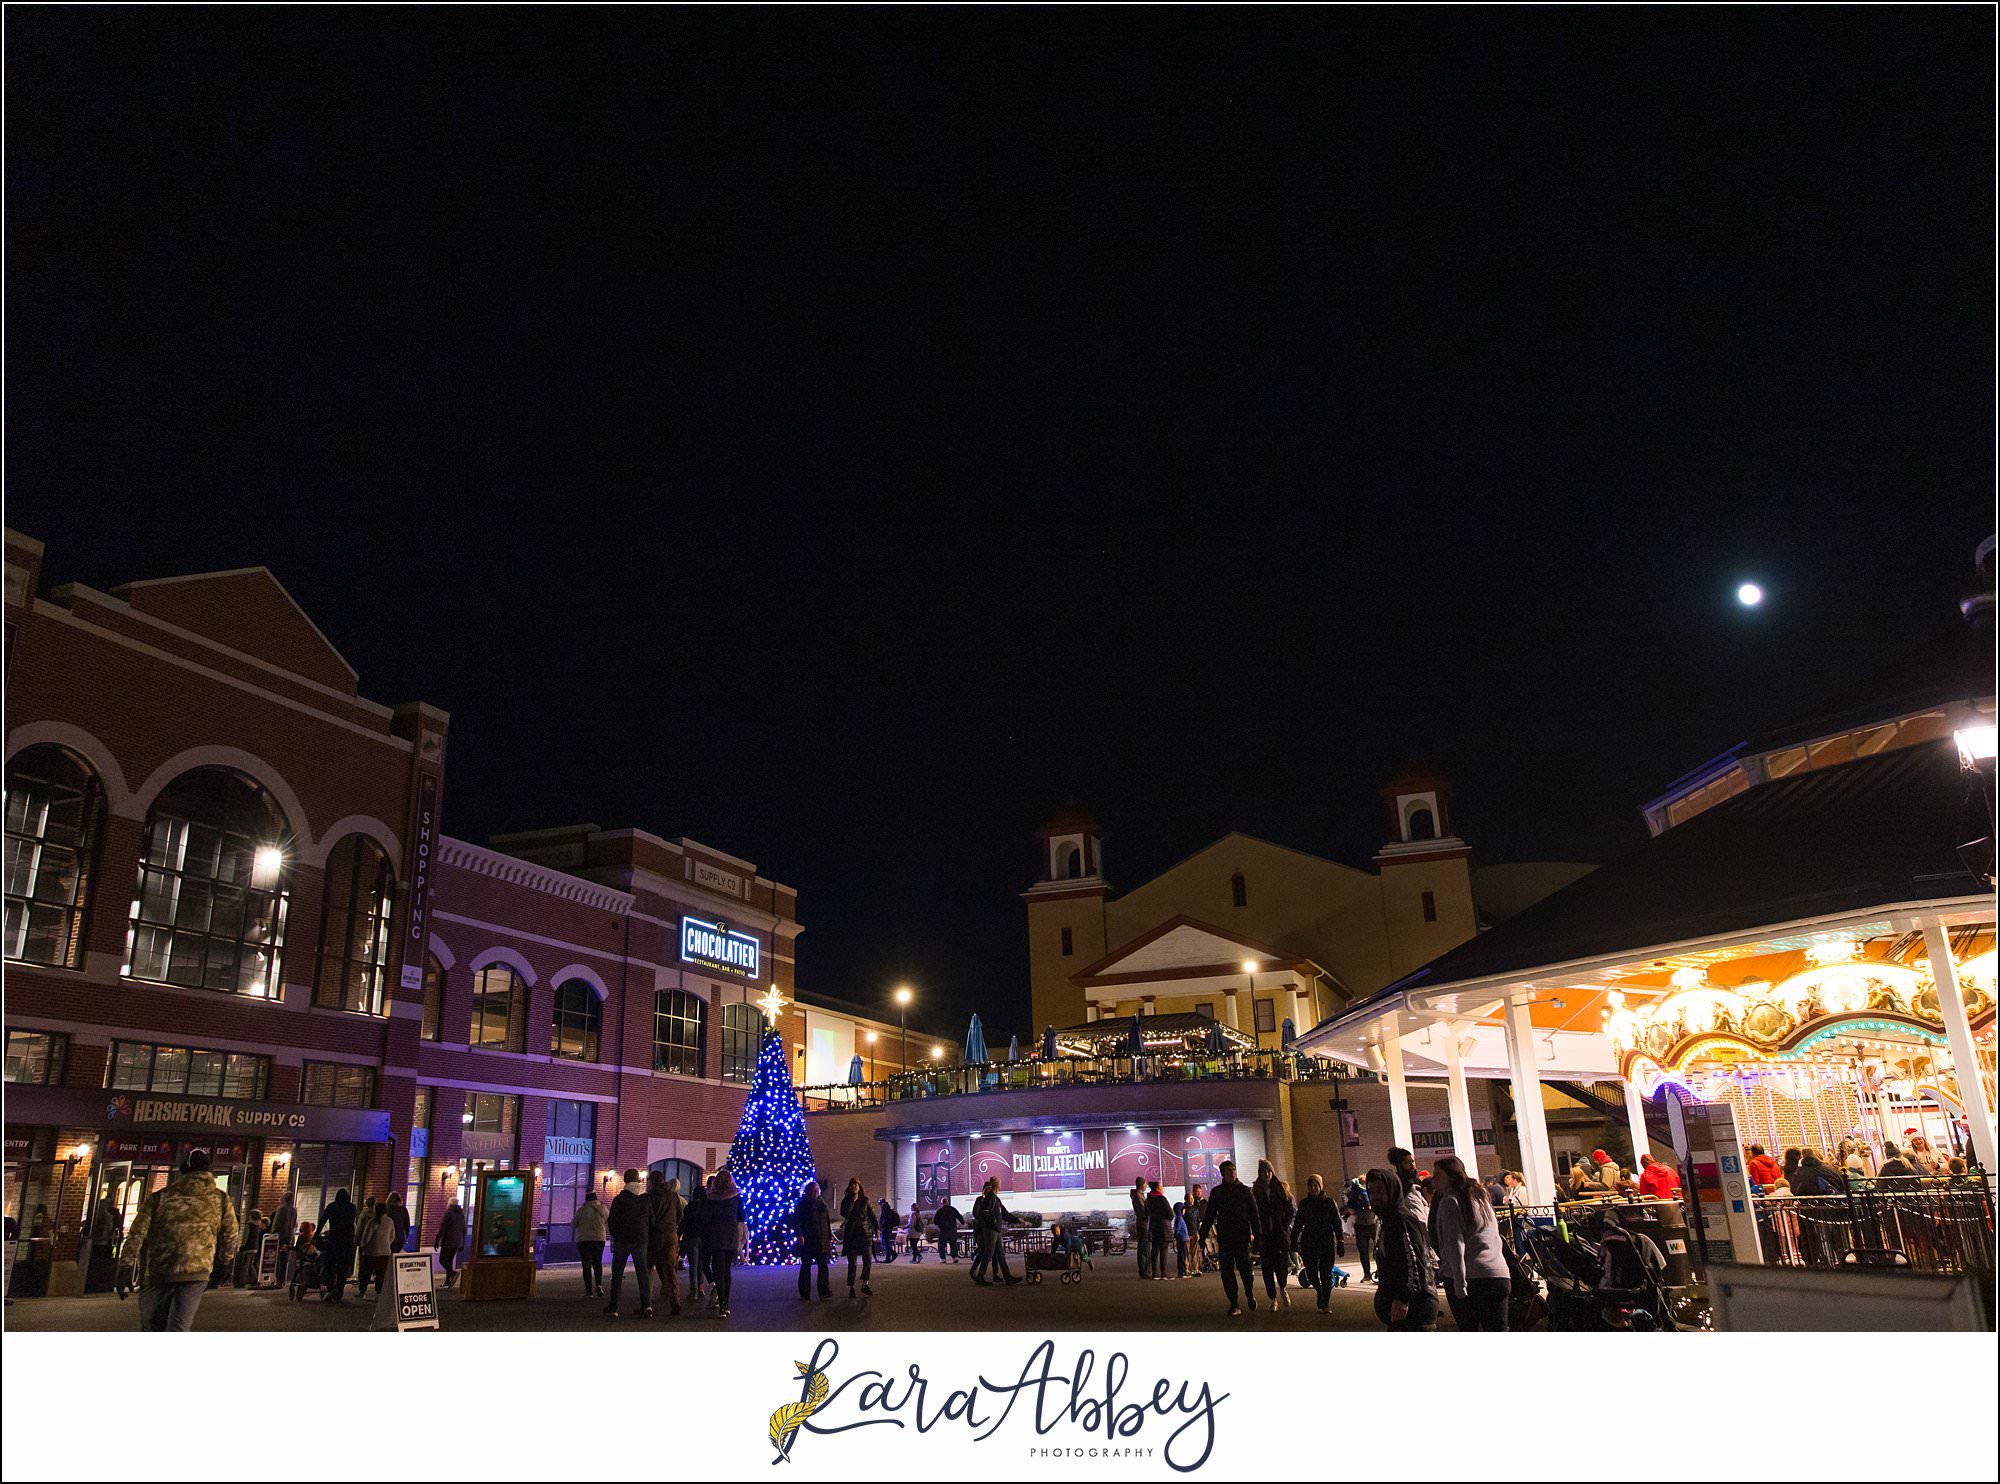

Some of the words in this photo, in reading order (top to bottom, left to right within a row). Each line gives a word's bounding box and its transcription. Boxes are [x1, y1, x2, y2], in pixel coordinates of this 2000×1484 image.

[411, 812, 431, 939] SHOPPING
[699, 868, 726, 886] SUPPLY
[687, 927, 755, 969] CHOCOLATIER
[133, 1099, 235, 1128] HERSHEYPARK
[236, 1110, 286, 1127] SUPPLY
[5, 1140, 30, 1148] ENTRY
[1414, 1132, 1444, 1146] PATIO
[119, 1143, 138, 1151] PARK
[216, 1147, 230, 1155] EXIT
[545, 1138, 590, 1155] Milton's
[1669, 1242, 1684, 1252] WM
[404, 1294, 428, 1303] STORE
[402, 1303, 432, 1317] OPEN
